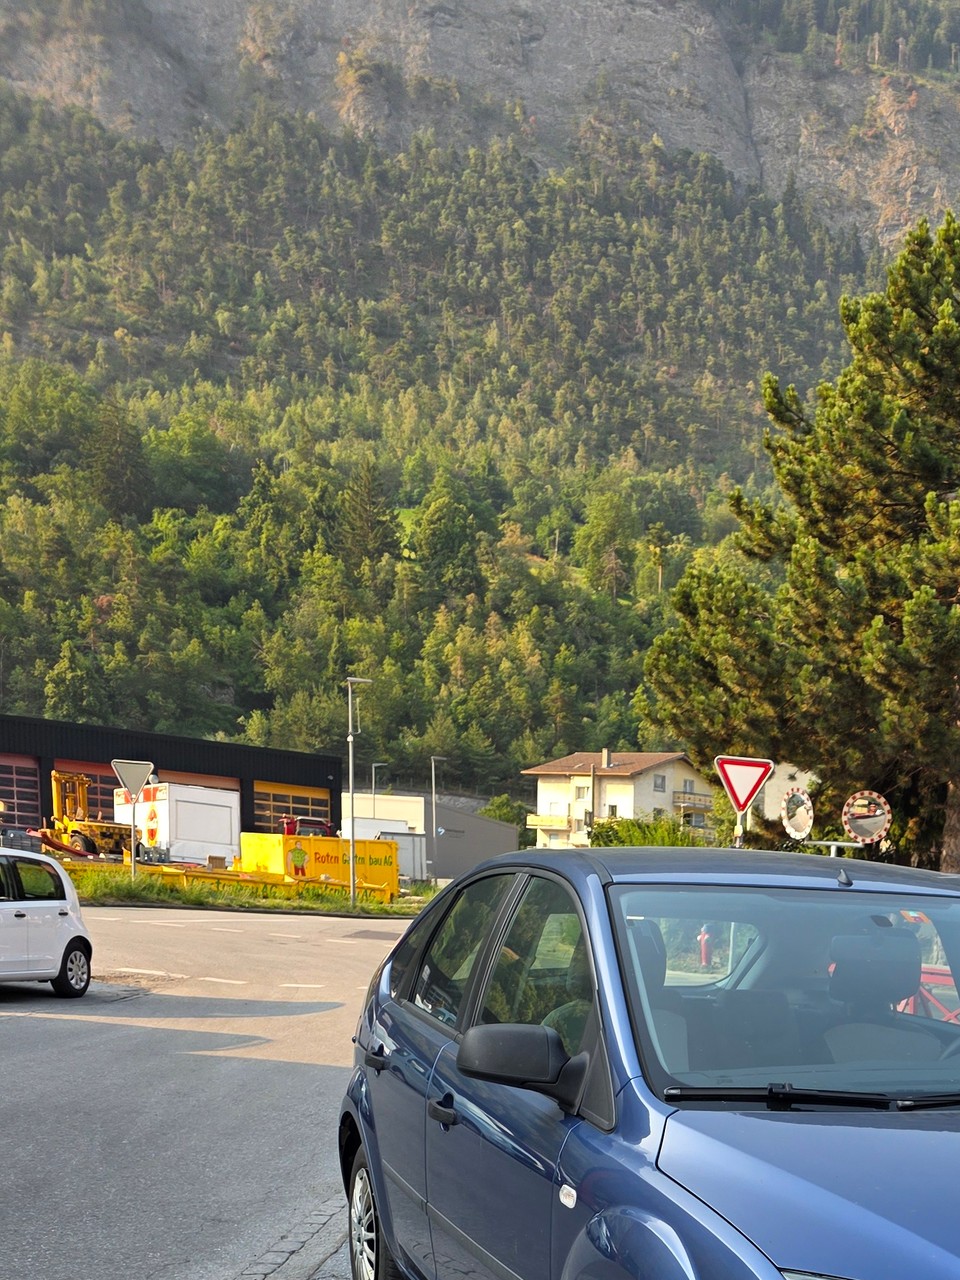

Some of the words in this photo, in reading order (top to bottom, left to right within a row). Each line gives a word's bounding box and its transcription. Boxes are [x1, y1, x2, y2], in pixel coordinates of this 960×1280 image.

[314, 852, 339, 864] Roten
[342, 853, 365, 865] Gaten
[369, 855, 382, 866] bau
[384, 855, 393, 866] AG
